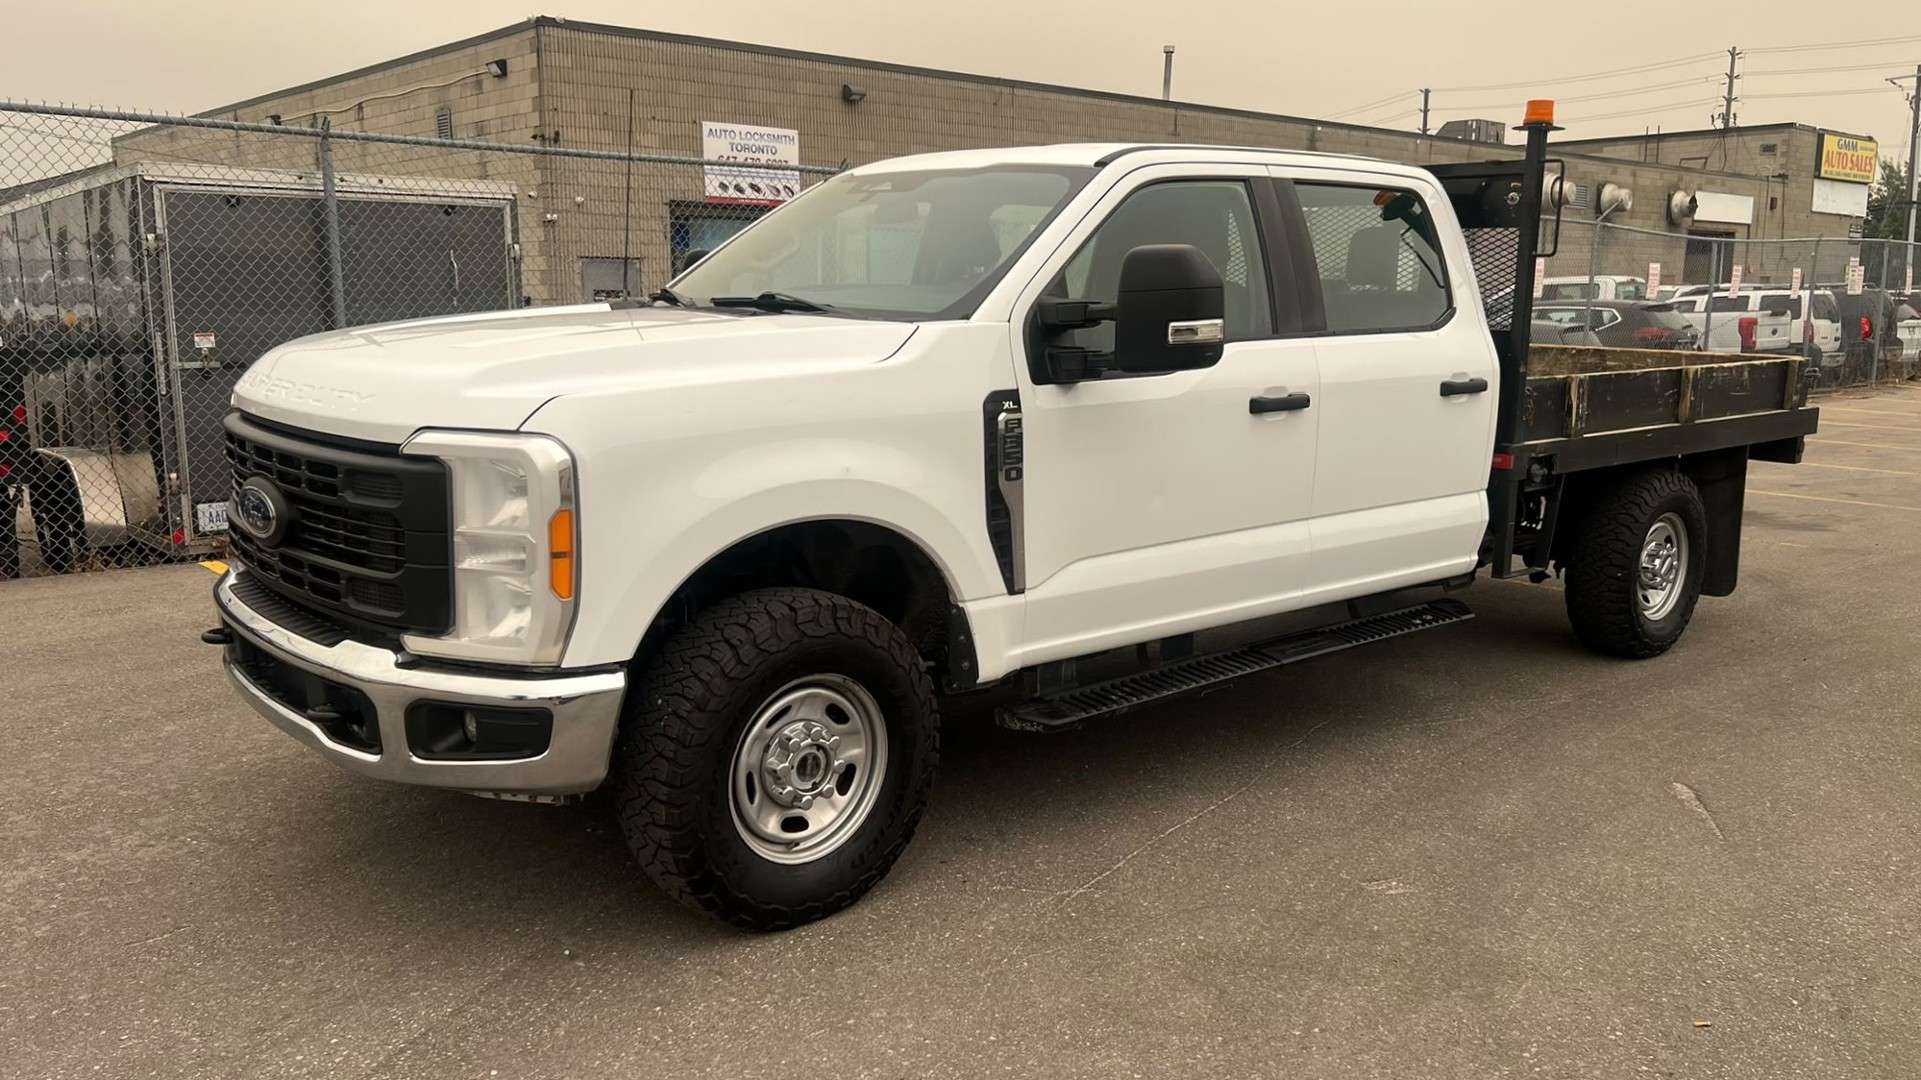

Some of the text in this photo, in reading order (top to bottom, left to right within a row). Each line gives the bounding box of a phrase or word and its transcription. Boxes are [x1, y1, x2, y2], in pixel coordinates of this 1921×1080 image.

[707, 128, 795, 145] AUTO LOCKSMITH
[729, 142, 778, 155] TORONTO
[1824, 150, 1873, 173] AUTO SALES
[1002, 401, 1018, 410] XL
